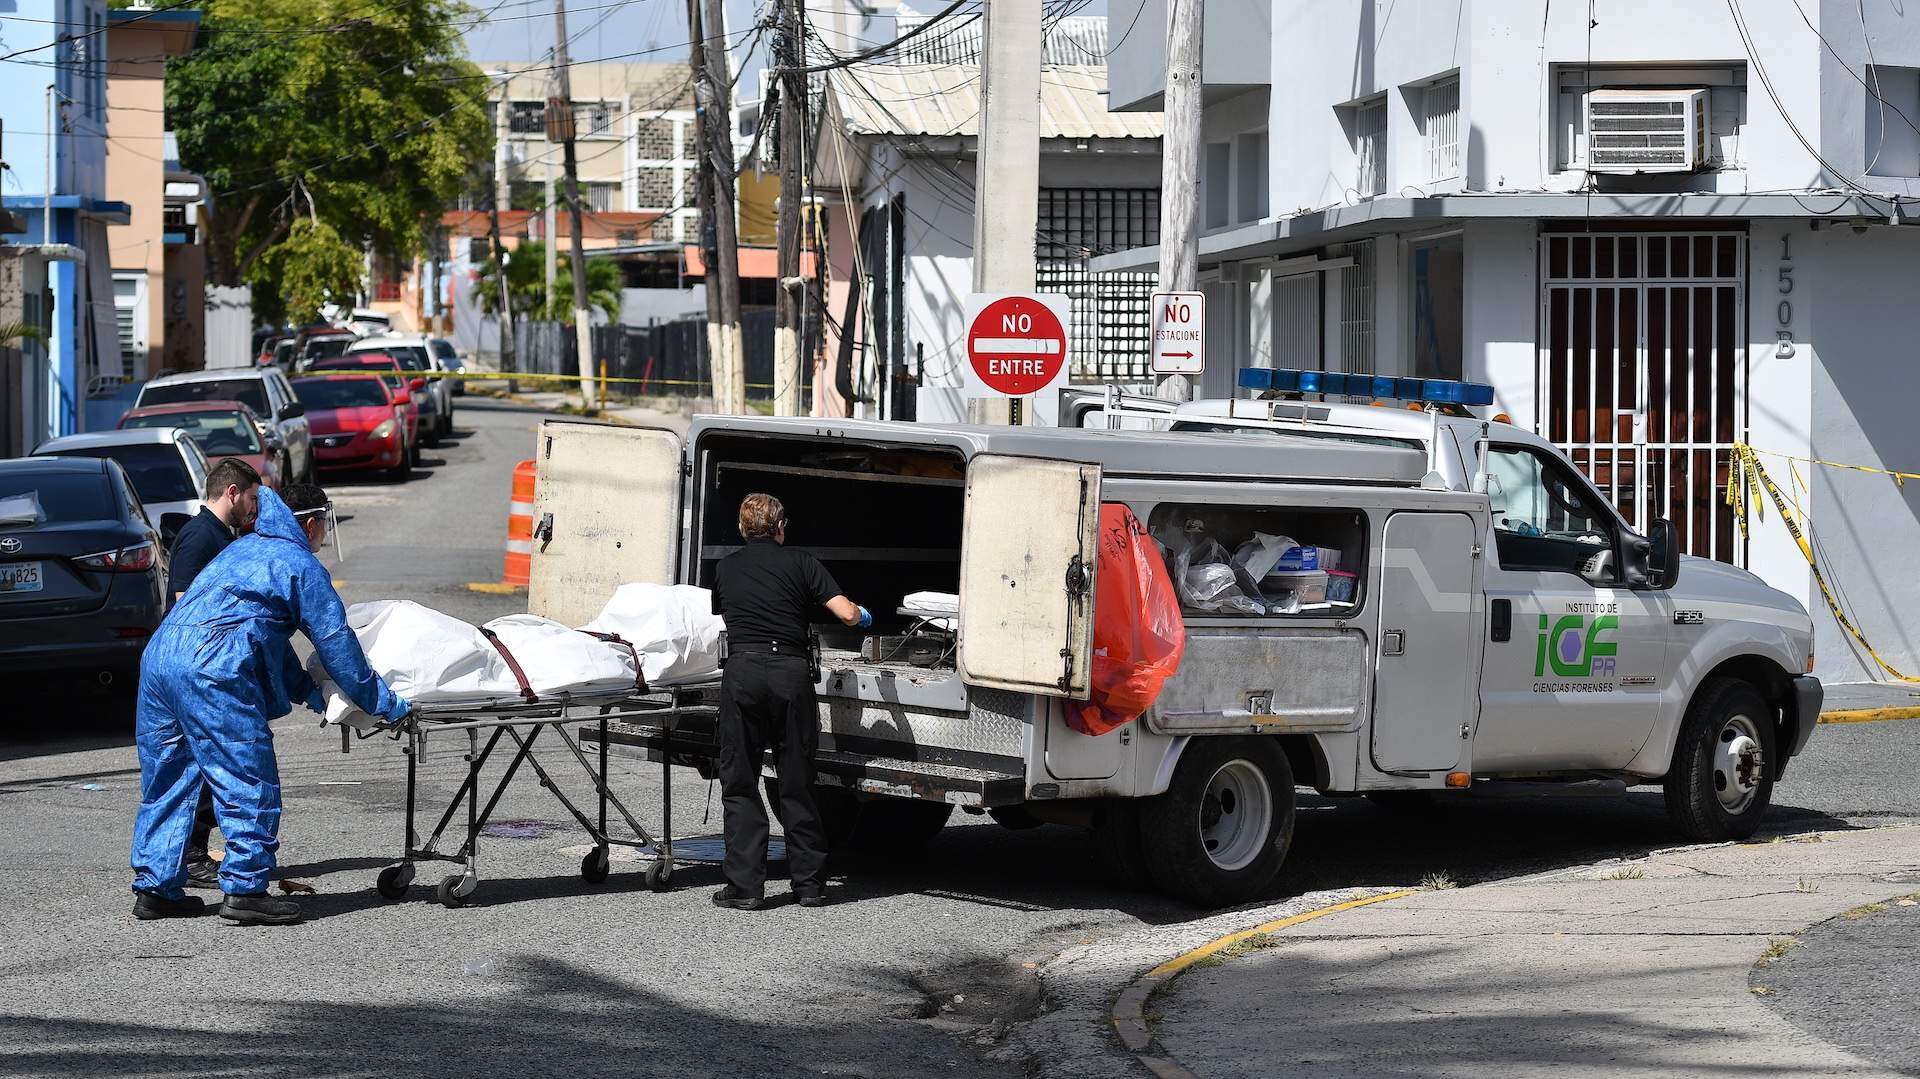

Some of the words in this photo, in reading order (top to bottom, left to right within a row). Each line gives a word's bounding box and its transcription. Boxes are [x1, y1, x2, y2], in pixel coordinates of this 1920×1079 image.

[1776, 233, 1795, 359] 150B
[1166, 304, 1190, 323] NO
[1002, 313, 1032, 333] NO
[1156, 330, 1200, 341] ESTACIONE
[989, 359, 1045, 375] ENTRE
[1787, 516, 1802, 539] CRIME
[16, 568, 37, 582] 825
[1565, 602, 1605, 613] INSTITUTO
[1607, 603, 1617, 613] DE
[1591, 657, 1616, 677] PR
[1533, 682, 1569, 693] CIENCIAS
[1571, 682, 1613, 693] FORENSES
